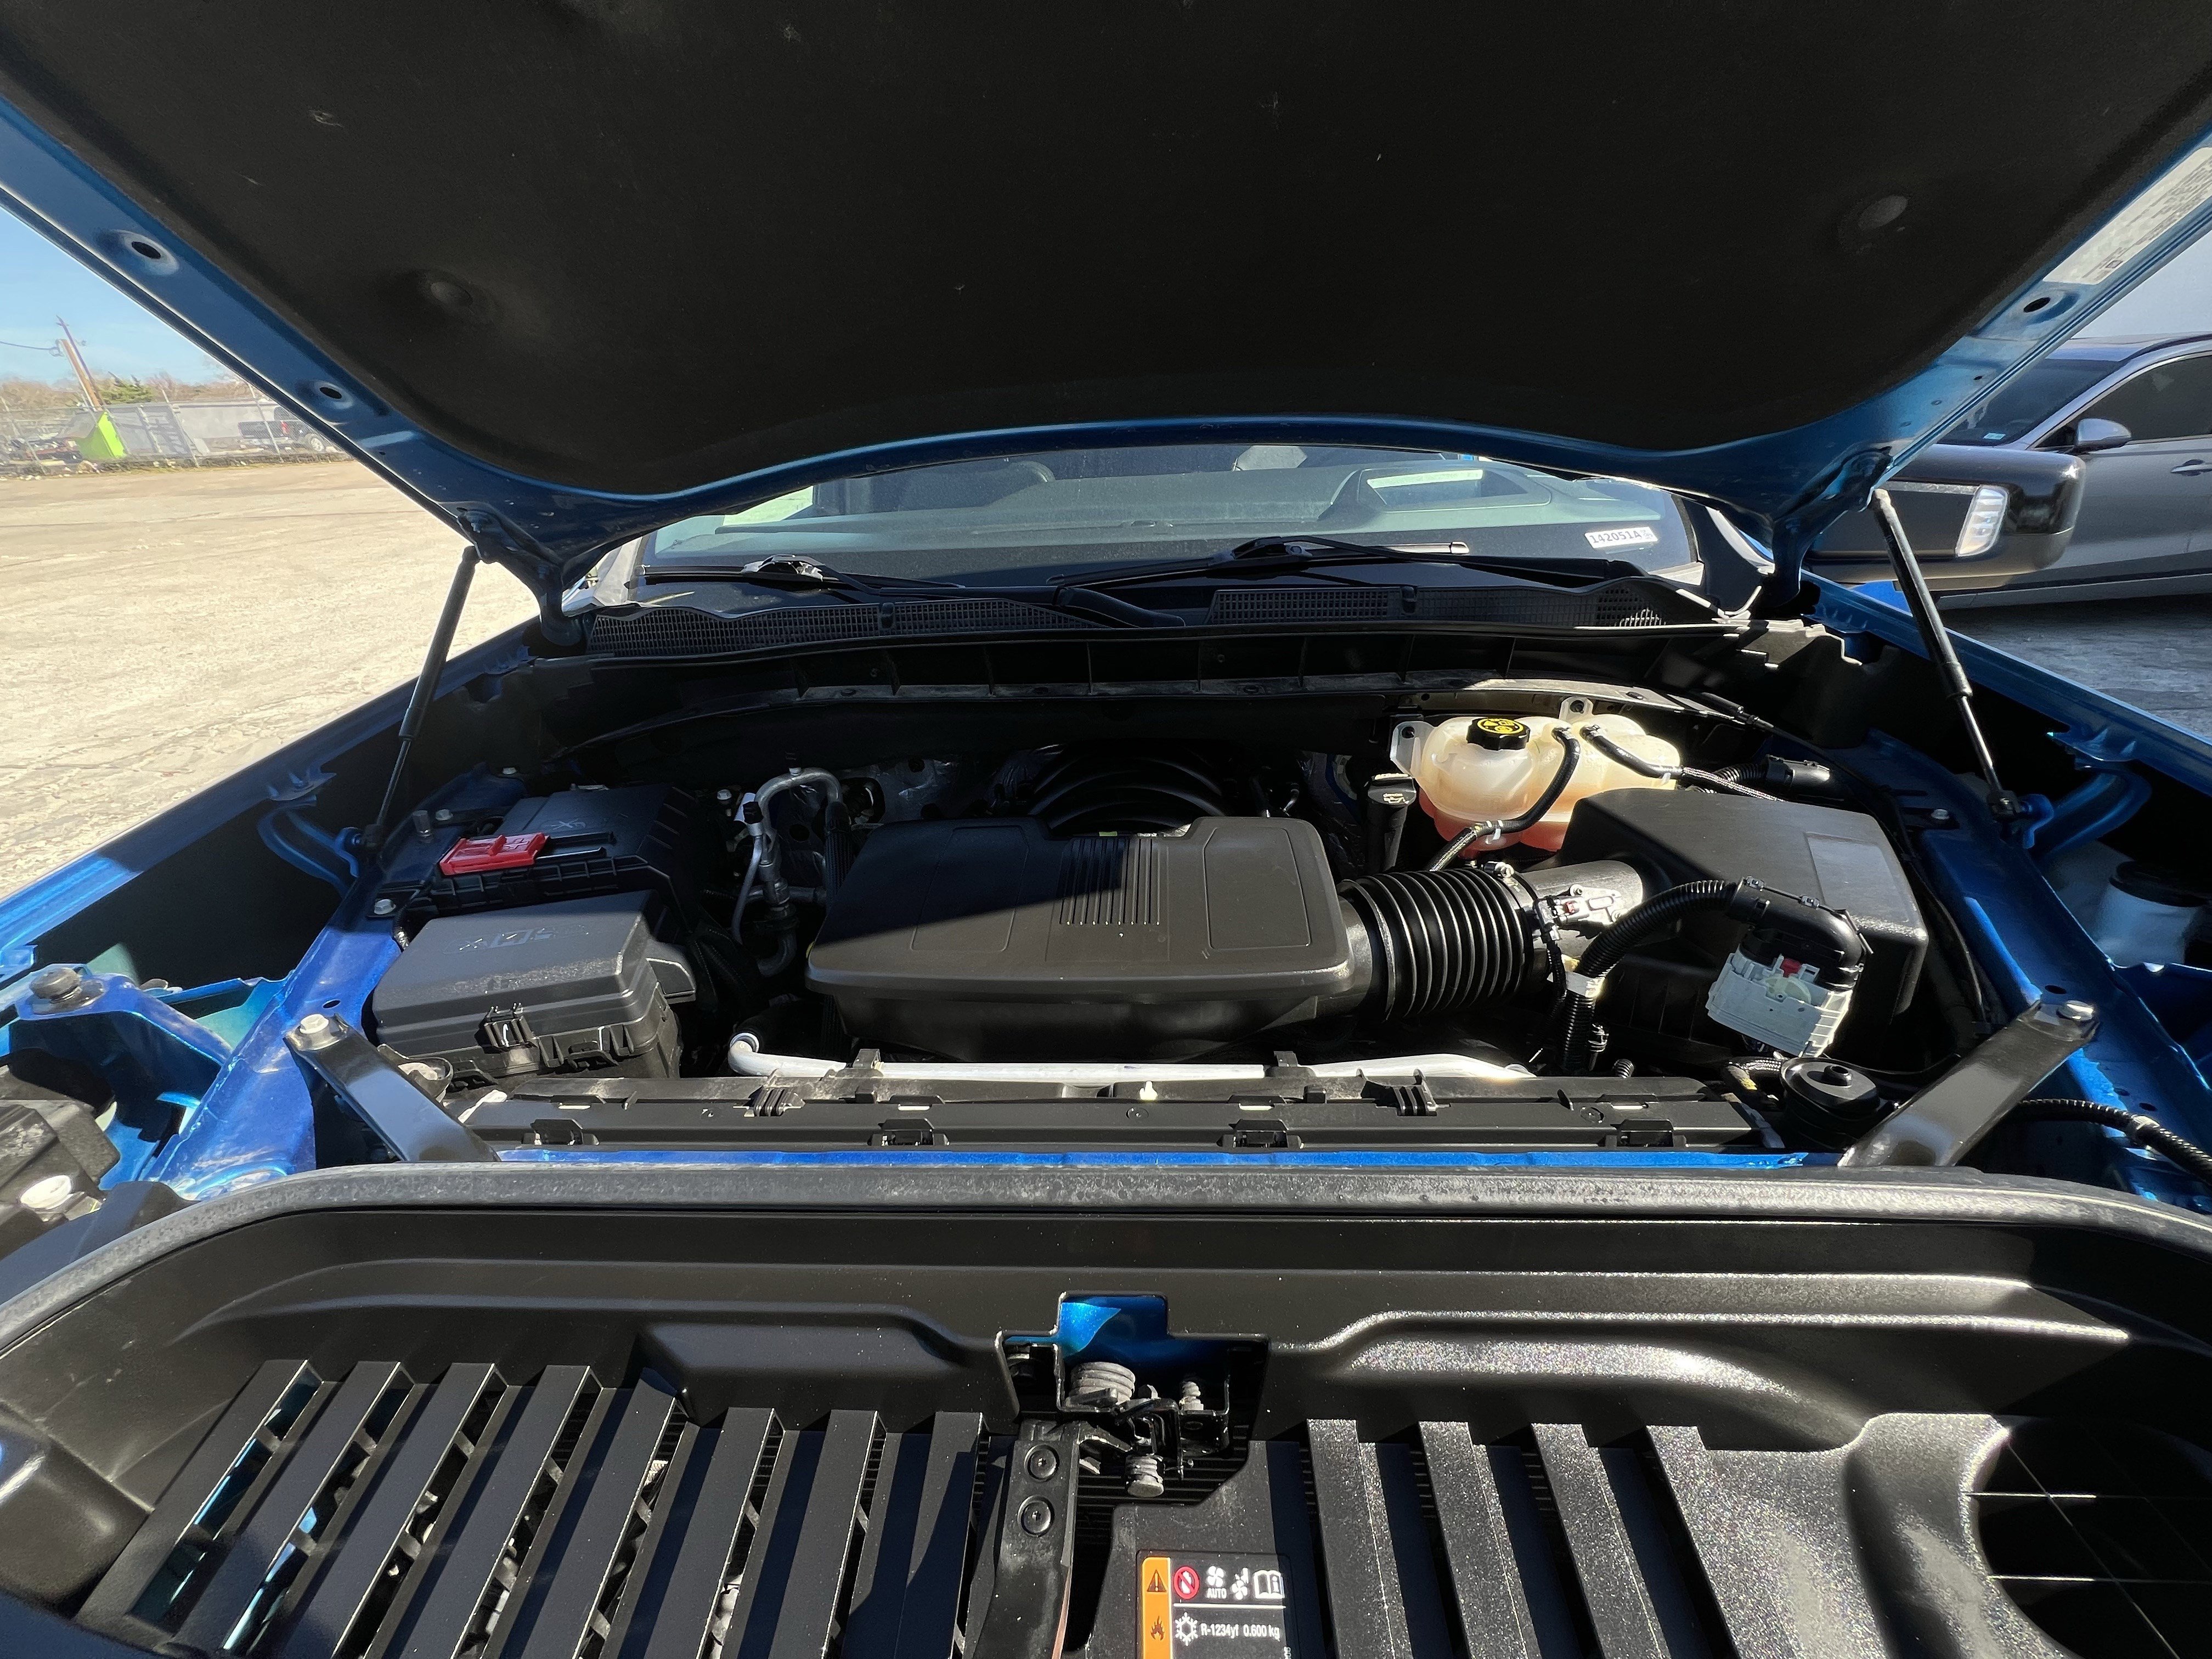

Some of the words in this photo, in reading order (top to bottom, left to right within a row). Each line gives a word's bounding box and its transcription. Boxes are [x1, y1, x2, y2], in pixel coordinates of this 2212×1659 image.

[1589, 531, 1642, 544] 142051A
[1206, 1588, 1227, 1599] AUTO
[1200, 1623, 1239, 1639] R-1234yf
[1243, 1624, 1267, 1637] 0.600
[1268, 1624, 1280, 1641] kg
